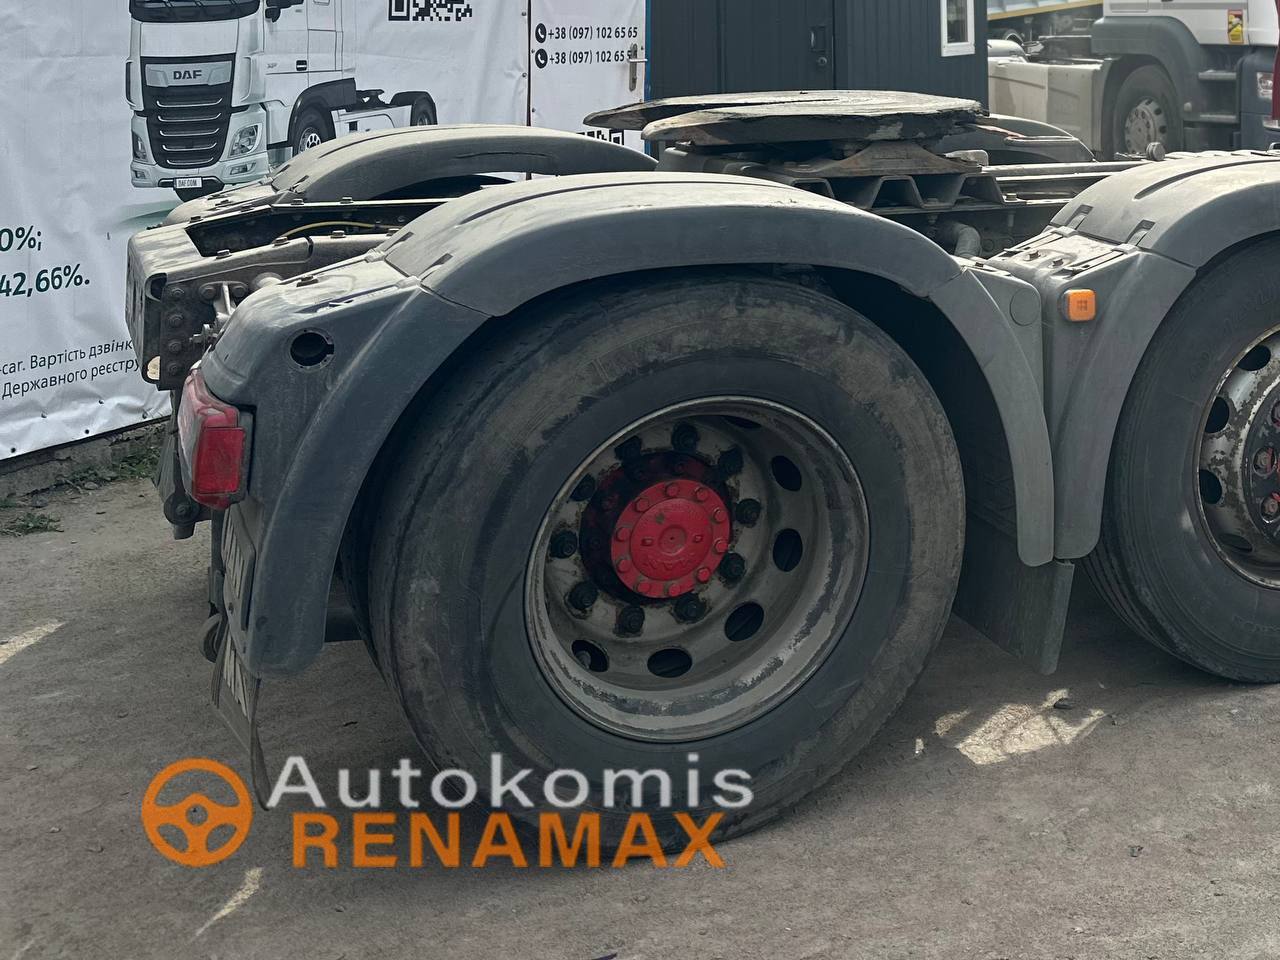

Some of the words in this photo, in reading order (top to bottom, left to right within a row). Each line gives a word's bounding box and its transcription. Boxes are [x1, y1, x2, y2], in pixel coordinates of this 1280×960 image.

[548, 27, 567, 40] +38
[568, 25, 593, 41] (097)
[596, 27, 612, 39] 102
[614, 27, 626, 39] 65
[627, 27, 638, 39] 65
[549, 52, 567, 65] +38
[568, 50, 593, 65] (097)
[595, 51, 612, 62] 102
[614, 50, 625, 62] 65
[173, 70, 203, 80] DAF
[30, 349, 86, 370] Вартість
[2, 368, 88, 399] Державного
[91, 358, 140, 381] реєстру
